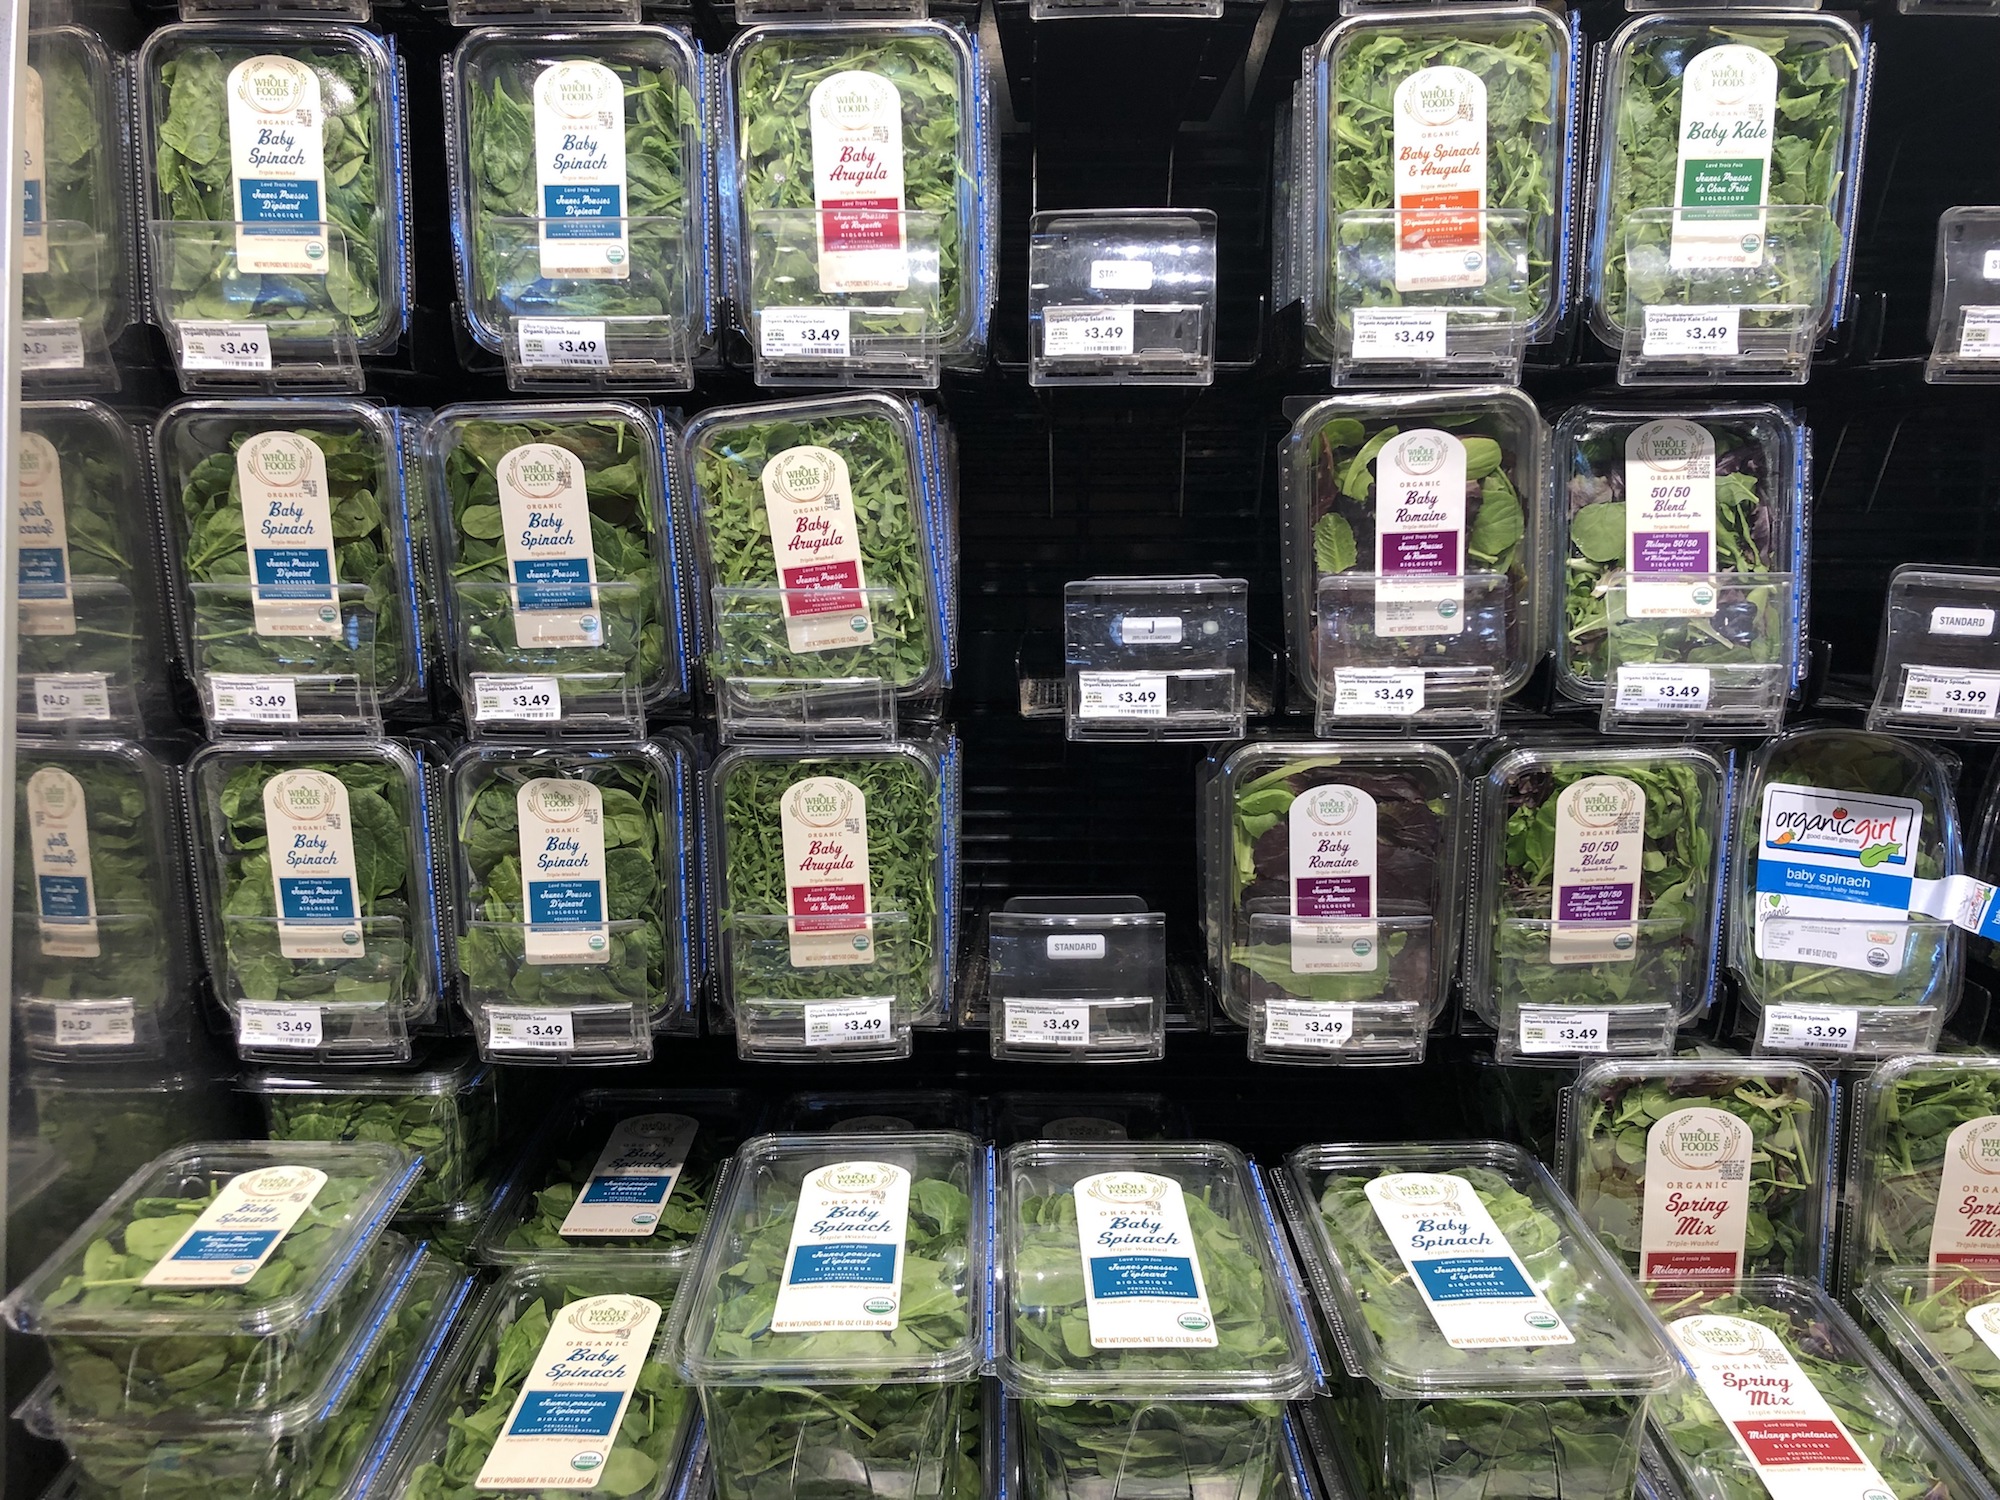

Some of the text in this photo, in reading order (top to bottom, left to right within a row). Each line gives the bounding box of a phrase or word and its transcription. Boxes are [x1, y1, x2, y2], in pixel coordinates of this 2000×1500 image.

[254, 79, 289, 87] WHOLE
[256, 87, 289, 96] FOODS
[1420, 89, 1455, 99] WHOLE
[1422, 98, 1455, 108] FOODS
[1687, 120, 1768, 146] Baby Kale
[257, 128, 295, 152] Baby
[562, 134, 598, 156] Baby
[249, 148, 306, 168] Spinach
[840, 146, 876, 168] Baby
[1400, 142, 1481, 164] Baby Spinach
[553, 154, 608, 173] Spinach
[1409, 158, 1471, 180] & Arugula
[830, 163, 887, 187] Arugula
[1695, 172, 1752, 182] Jeunes Pousses
[801, 329, 840, 340] $3.49
[1085, 327, 1123, 338] $3.49
[1395, 331, 1434, 342] $3.49
[1686, 327, 1727, 339] $3.49
[221, 342, 259, 354] $3.49
[559, 341, 596, 352] $3.49
[1653, 440, 1686, 448] WHOLE
[262, 452, 296, 461] WHOLE
[1654, 448, 1686, 456] FOODS
[265, 462, 296, 470] FOODS
[521, 464, 554, 473] WHOLE
[524, 473, 555, 481] FOODS
[786, 468, 820, 478] WHOLE
[789, 477, 820, 487] FOODS
[1400, 480, 1441, 488] ORGANIC
[1651, 487, 1691, 498] 50/50
[1404, 490, 1439, 509] Baby
[1653, 499, 1686, 512] Blend
[269, 501, 304, 522] Baby
[1395, 508, 1447, 523] Romaine
[261, 519, 315, 538] Spinach
[528, 512, 564, 533] Baby
[796, 516, 831, 536] Baby
[521, 530, 575, 550] Spinach
[788, 529, 844, 554] Arugula
[1148, 621, 1155, 633] J
[1939, 617, 1985, 627] STANDARD
[1118, 692, 1156, 703] $3.49
[1374, 688, 1414, 699] $3.49
[1659, 686, 1700, 697] $3.49
[1946, 690, 1987, 702] $3.99
[249, 696, 286, 706] $3.49
[513, 694, 550, 706] $3.49
[542, 793, 574, 801] WHOLE
[805, 796, 837, 805] WHOLE
[1584, 796, 1619, 804] WHOLE
[544, 800, 575, 808] FOODS
[807, 804, 837, 813] FOODS
[1586, 804, 1617, 812] FOODS
[1776, 809, 1897, 849] organicgirl
[294, 834, 328, 853] Baby
[1806, 832, 1859, 845] good clean greens
[546, 837, 581, 855] Baby
[809, 841, 844, 859] Baby
[1318, 839, 1351, 856] Baby
[1580, 841, 1619, 853] 50/50
[286, 851, 339, 868] Spinach
[537, 853, 589, 872] Spinach
[800, 854, 854, 875] Arugula
[1309, 856, 1359, 869] Romaine
[1581, 854, 1614, 866] Blend
[1786, 868, 1871, 889] baby spinach
[1054, 943, 1097, 951] STANDARD
[277, 1022, 312, 1032] $3.49
[527, 1025, 562, 1035] $3.49
[845, 1019, 881, 1030] $3.49
[1043, 1019, 1080, 1029] $3.49
[1305, 1022, 1343, 1032] $3.49
[1560, 1029, 1597, 1039] $3.49
[1806, 1026, 1847, 1038] $3.99
[1680, 1133, 1720, 1141] WHOLE
[1681, 1142, 1719, 1151] FOODS
[624, 1149, 665, 1162] Baby
[608, 1159, 672, 1170] Spinach
[1962, 1185, 2000, 1193] ORGA
[235, 1203, 277, 1216] Baby
[1665, 1192, 1729, 1220] Spring
[1959, 1195, 2000, 1219] Spri
[216, 1213, 280, 1224] Spinach
[826, 1206, 881, 1222] Baby
[809, 1219, 893, 1236] Spinach
[1109, 1217, 1162, 1233] Baby
[1416, 1219, 1470, 1235] Baby
[1675, 1216, 1716, 1236] Mix
[1098, 1232, 1180, 1247] Spinach
[1411, 1233, 1494, 1250] Spinach
[1652, 1264, 1730, 1275] Mélange printanier
[566, 1348, 619, 1367] Baby
[545, 1364, 627, 1381] Spinach
[1722, 1372, 1793, 1392] Spring
[1746, 1390, 1794, 1406] Mix
[1747, 1431, 1839, 1441] Mélange printanier
